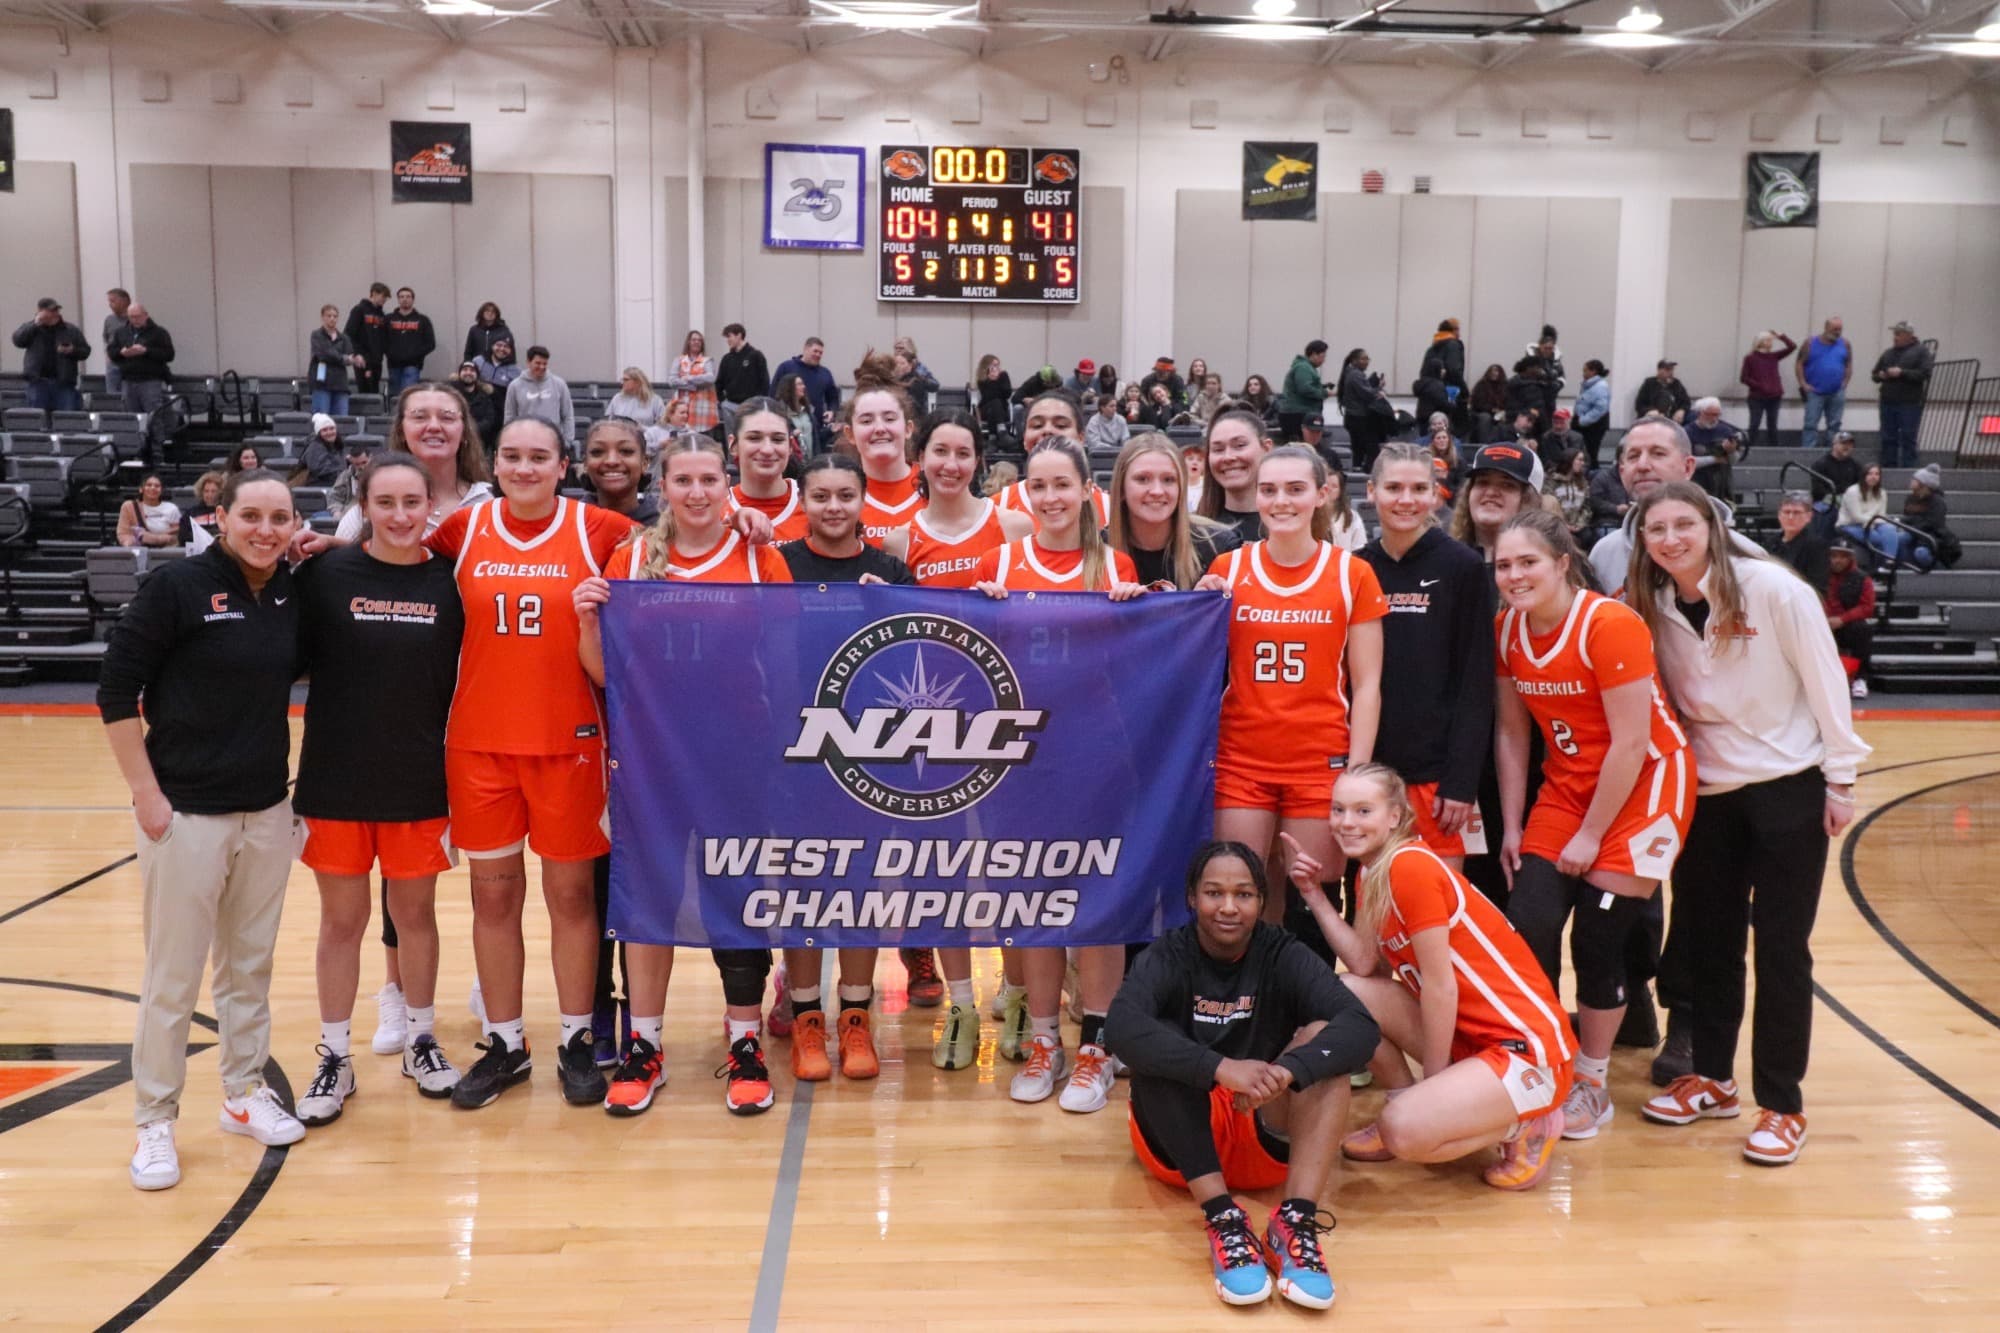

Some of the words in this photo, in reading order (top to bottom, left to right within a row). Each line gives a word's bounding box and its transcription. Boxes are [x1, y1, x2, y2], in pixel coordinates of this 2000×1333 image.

[891, 187, 934, 203] HOME
[962, 197, 998, 209] PERIOD
[1024, 190, 1072, 205] GUEST
[887, 207, 937, 239] 104
[972, 213, 990, 237] 4
[1031, 211, 1073, 240] 41
[883, 243, 915, 254] FOULS
[948, 244, 985, 255] PLAYER
[988, 245, 1013, 256] FOUL
[1044, 246, 1076, 256] FOULS
[895, 255, 911, 281] 5
[924, 261, 938, 280] 2
[1027, 263, 1035, 280] 1
[1055, 258, 1072, 283] 5
[883, 285, 915, 296] SCORE
[962, 286, 997, 297] MATCH
[1043, 288, 1075, 299] SCORE
[473, 560, 568, 578] COBLESKILL
[211, 592, 228, 613] C
[350, 597, 438, 617] COBLESKILL
[353, 612, 391, 621] Women's
[392, 613, 435, 625] Basketball
[495, 592, 543, 636] 12
[1236, 605, 1333, 624] COBLESKILL
[825, 625, 895, 695] NORTH
[906, 621, 1013, 696] ATLANTIC
[1255, 640, 1306, 683] 25
[1512, 676, 1586, 696] OBLESKILL
[783, 706, 1047, 760] NAC
[1551, 718, 1580, 756] 2
[843, 767, 995, 812] CONFERENCE
[1646, 836, 1672, 858] C
[703, 837, 864, 878] WEST
[873, 837, 1123, 878] DIVISION
[742, 889, 1080, 929] CHAMPIONS
